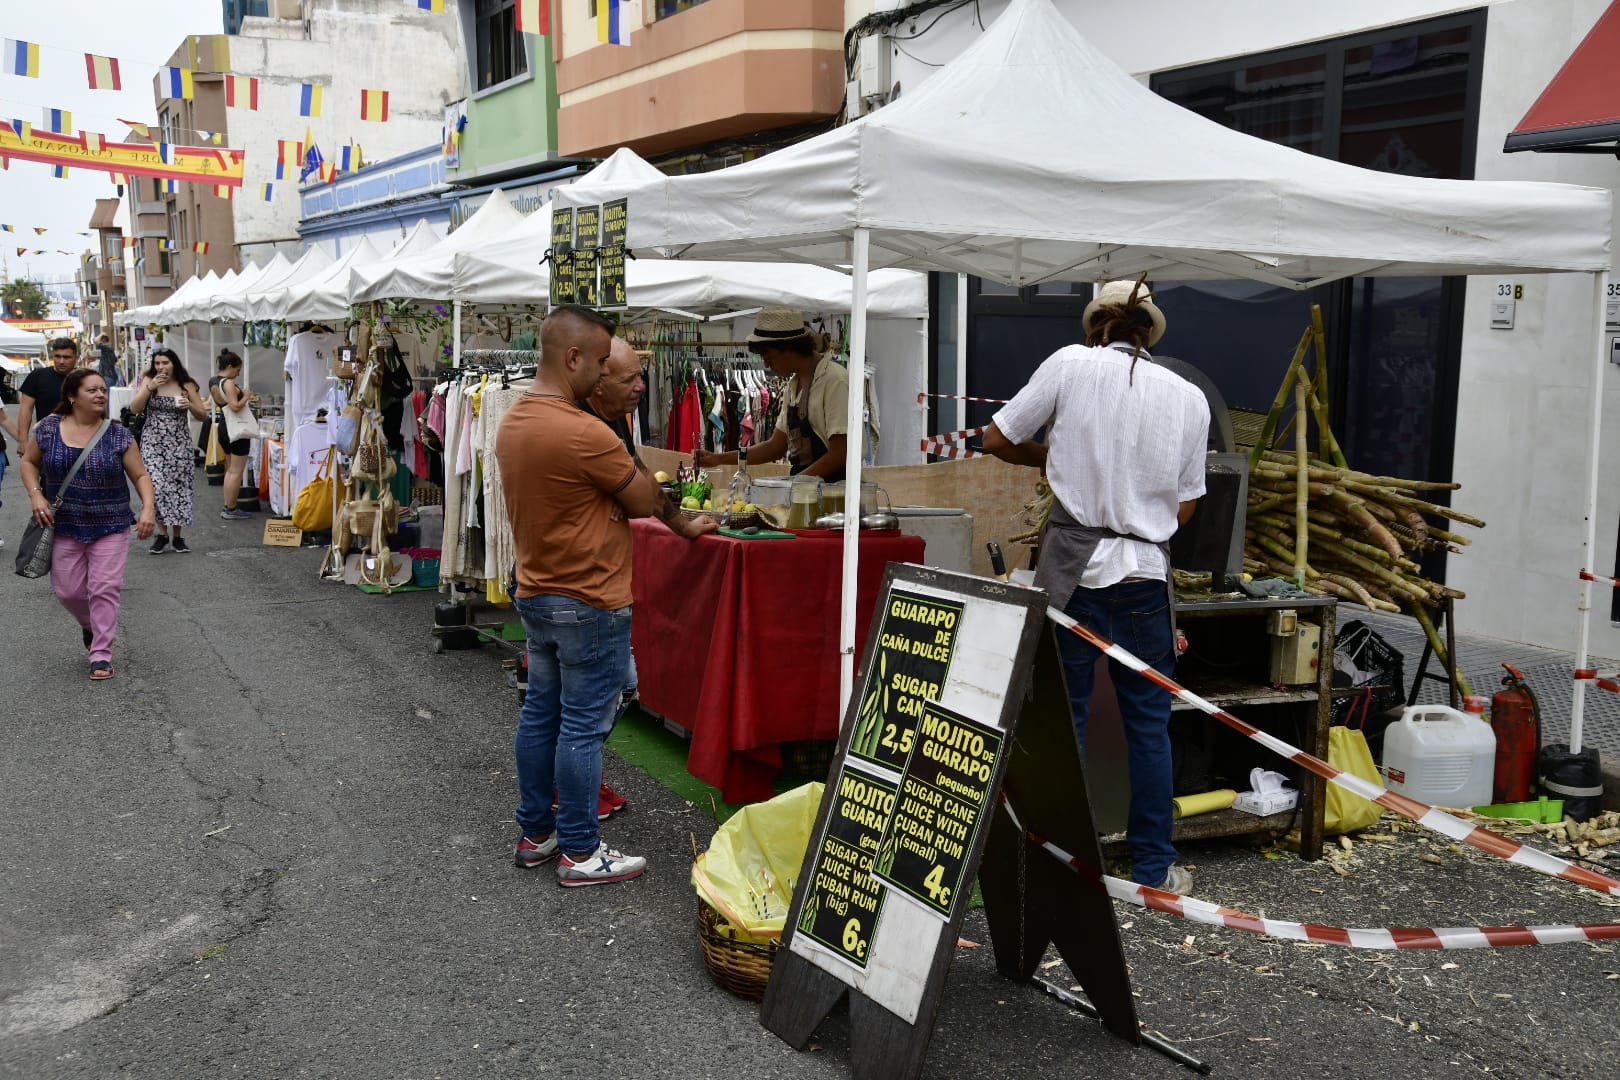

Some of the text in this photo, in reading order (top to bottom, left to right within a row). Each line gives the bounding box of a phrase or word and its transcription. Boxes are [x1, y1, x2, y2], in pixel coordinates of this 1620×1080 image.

[1498, 284, 1523, 300] 33 B
[891, 600, 956, 629] GUARAPO
[881, 633, 950, 663] CAÑA DULCE
[935, 630, 952, 646] DE
[891, 673, 939, 699] SUGAR
[896, 696, 925, 718] CAN
[881, 723, 914, 754] 2,5
[921, 713, 995, 764] MOJITO DE
[922, 738, 990, 783] GUARAPO
[904, 779, 976, 825] SUGAR CANE
[936, 771, 985, 805] (pequeño)
[841, 800, 888, 833] GUARA
[900, 796, 968, 841] JUICE WITH
[895, 813, 964, 860] CUBAN RUM
[899, 832, 938, 865] (small)
[824, 839, 873, 873] SUGAR CA
[816, 872, 877, 913] CUBAN RUM
[821, 856, 880, 895] JUICE WITH
[923, 864, 951, 906] 4€
[825, 893, 849, 917] (big)
[842, 917, 868, 958] 6€
